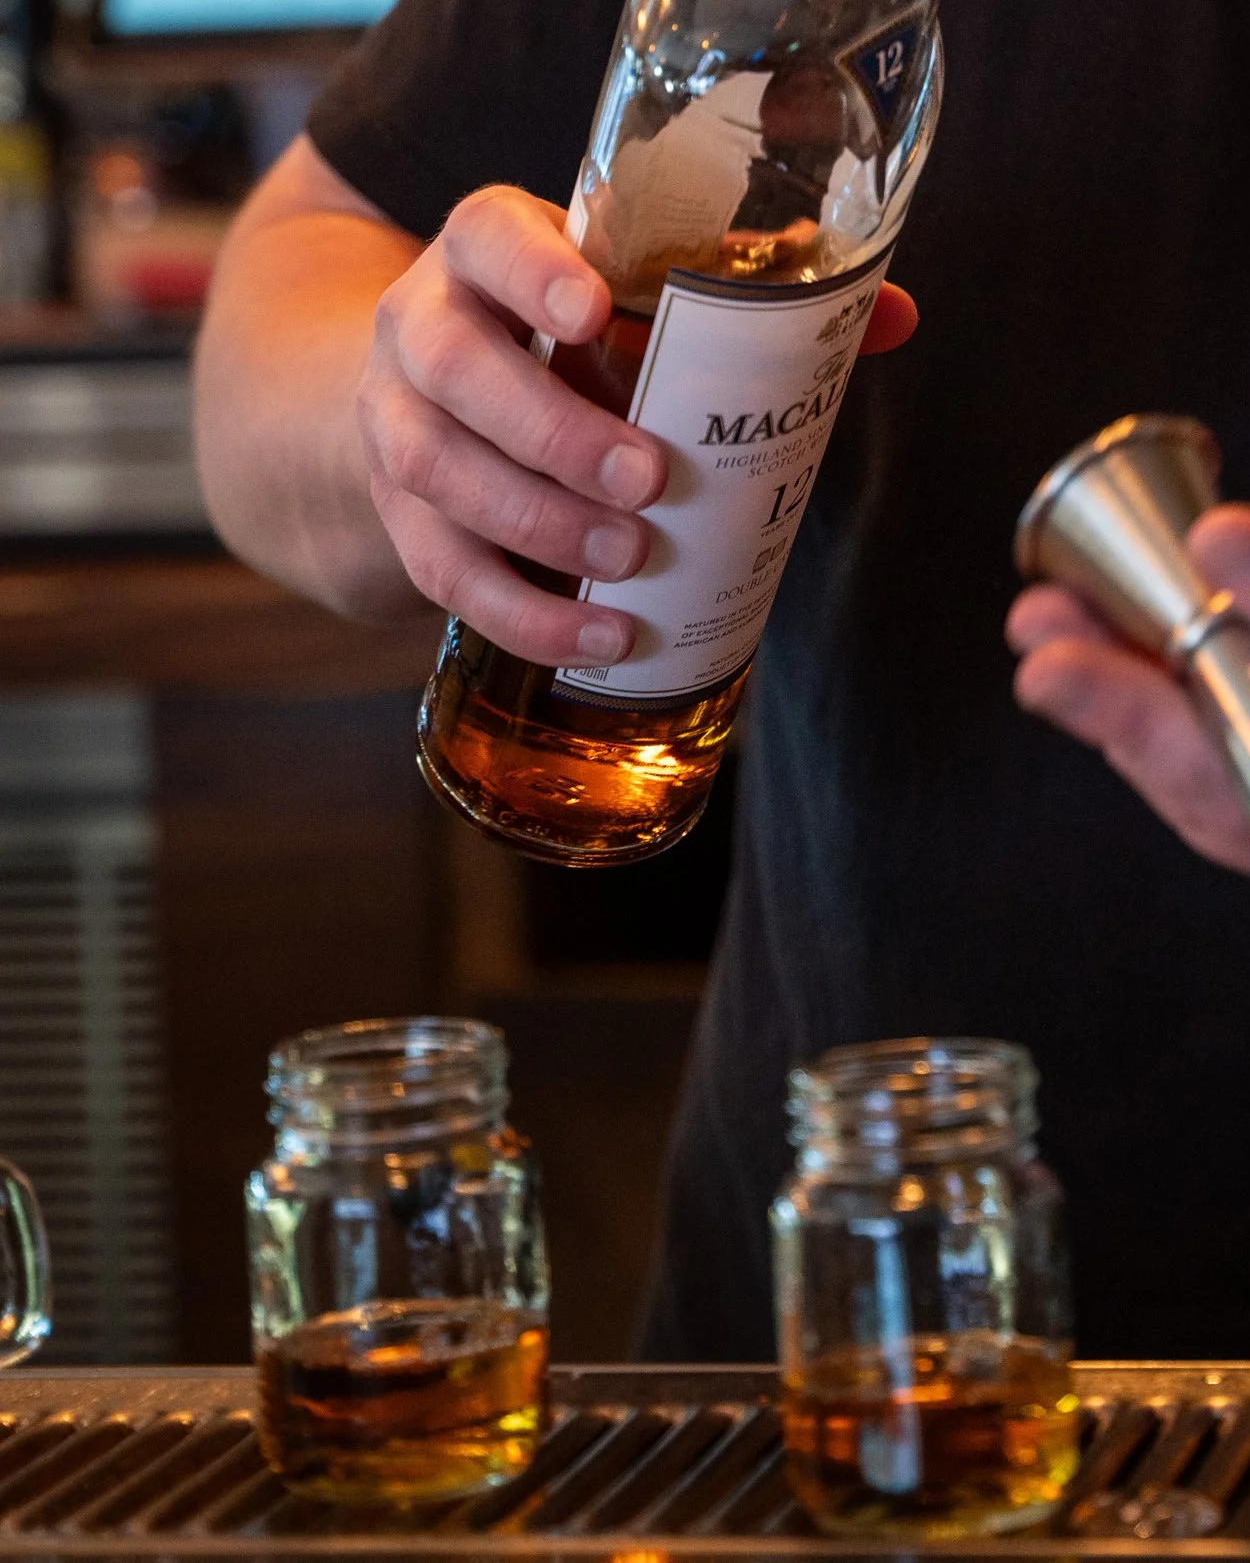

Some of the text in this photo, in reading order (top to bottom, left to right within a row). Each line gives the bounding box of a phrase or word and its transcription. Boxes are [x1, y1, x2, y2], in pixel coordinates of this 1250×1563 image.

[874, 40, 904, 86] 12
[715, 437, 803, 470] HIGHLAND
[748, 446, 806, 479] SCOTCH
[760, 464, 814, 529] 12
[673, 627, 738, 649] AMERICAN AND
[681, 632, 696, 640] OF
[696, 614, 750, 637] EXCEPTIONAL
[684, 614, 727, 630] MATURED
